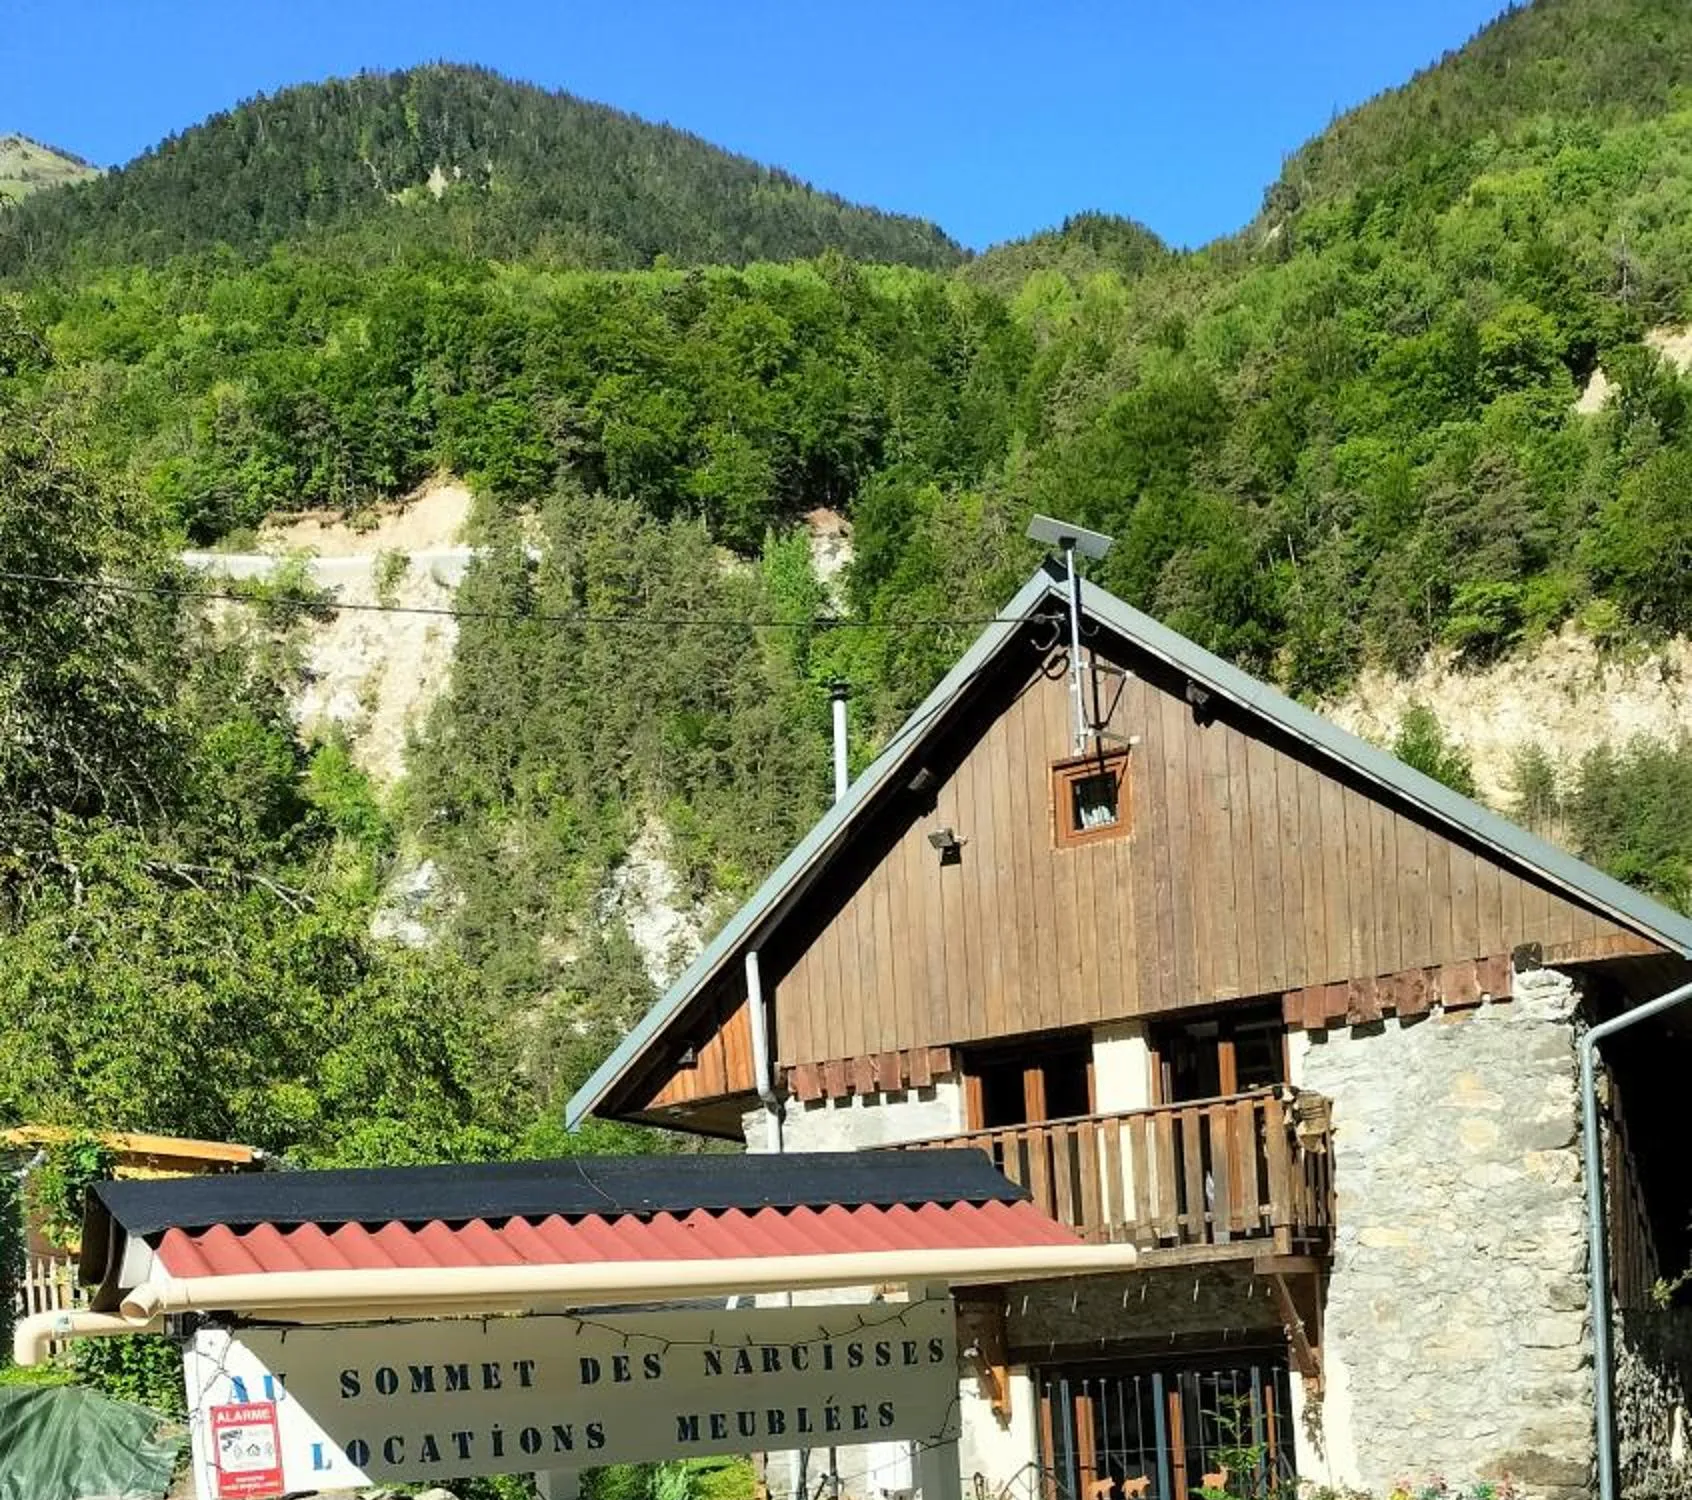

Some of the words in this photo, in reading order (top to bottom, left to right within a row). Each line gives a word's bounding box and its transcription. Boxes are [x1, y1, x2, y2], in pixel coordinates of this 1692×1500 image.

[228, 1374, 286, 1402] AU
[339, 1359, 535, 1398] SOMMET
[579, 1352, 662, 1385] DES
[703, 1338, 945, 1376] NARCISSES
[216, 1408, 271, 1424] ALARME
[675, 1396, 895, 1442] MEUBLÉES
